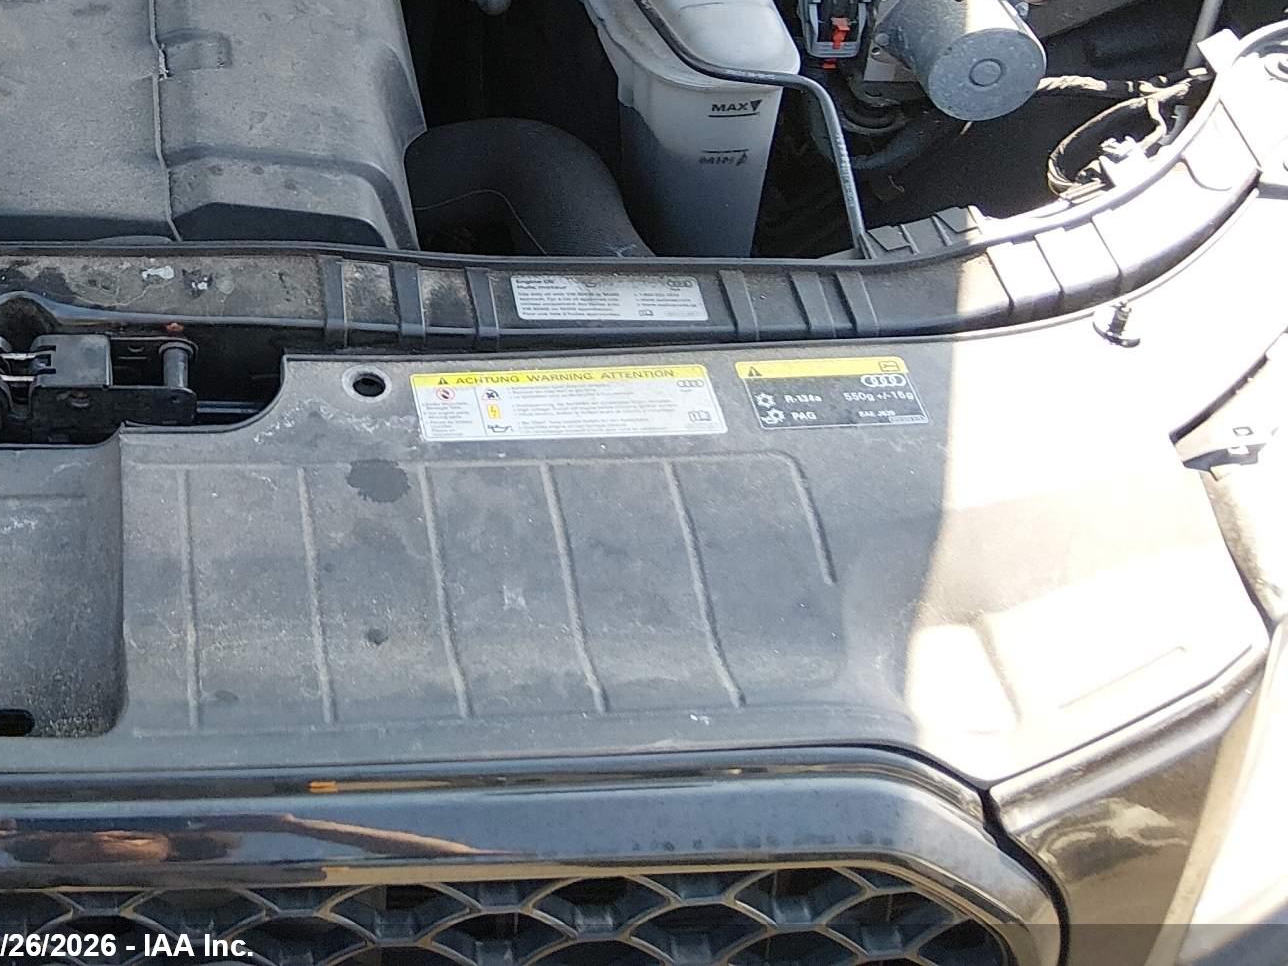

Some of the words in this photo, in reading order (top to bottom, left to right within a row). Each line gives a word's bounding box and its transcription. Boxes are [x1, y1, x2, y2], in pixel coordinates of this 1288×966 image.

[712, 102, 748, 112] MAX
[456, 375, 520, 384] ACHTUNG
[527, 372, 593, 382] WARNING
[600, 369, 675, 380] ATTENTION
[791, 410, 817, 420] PAG
